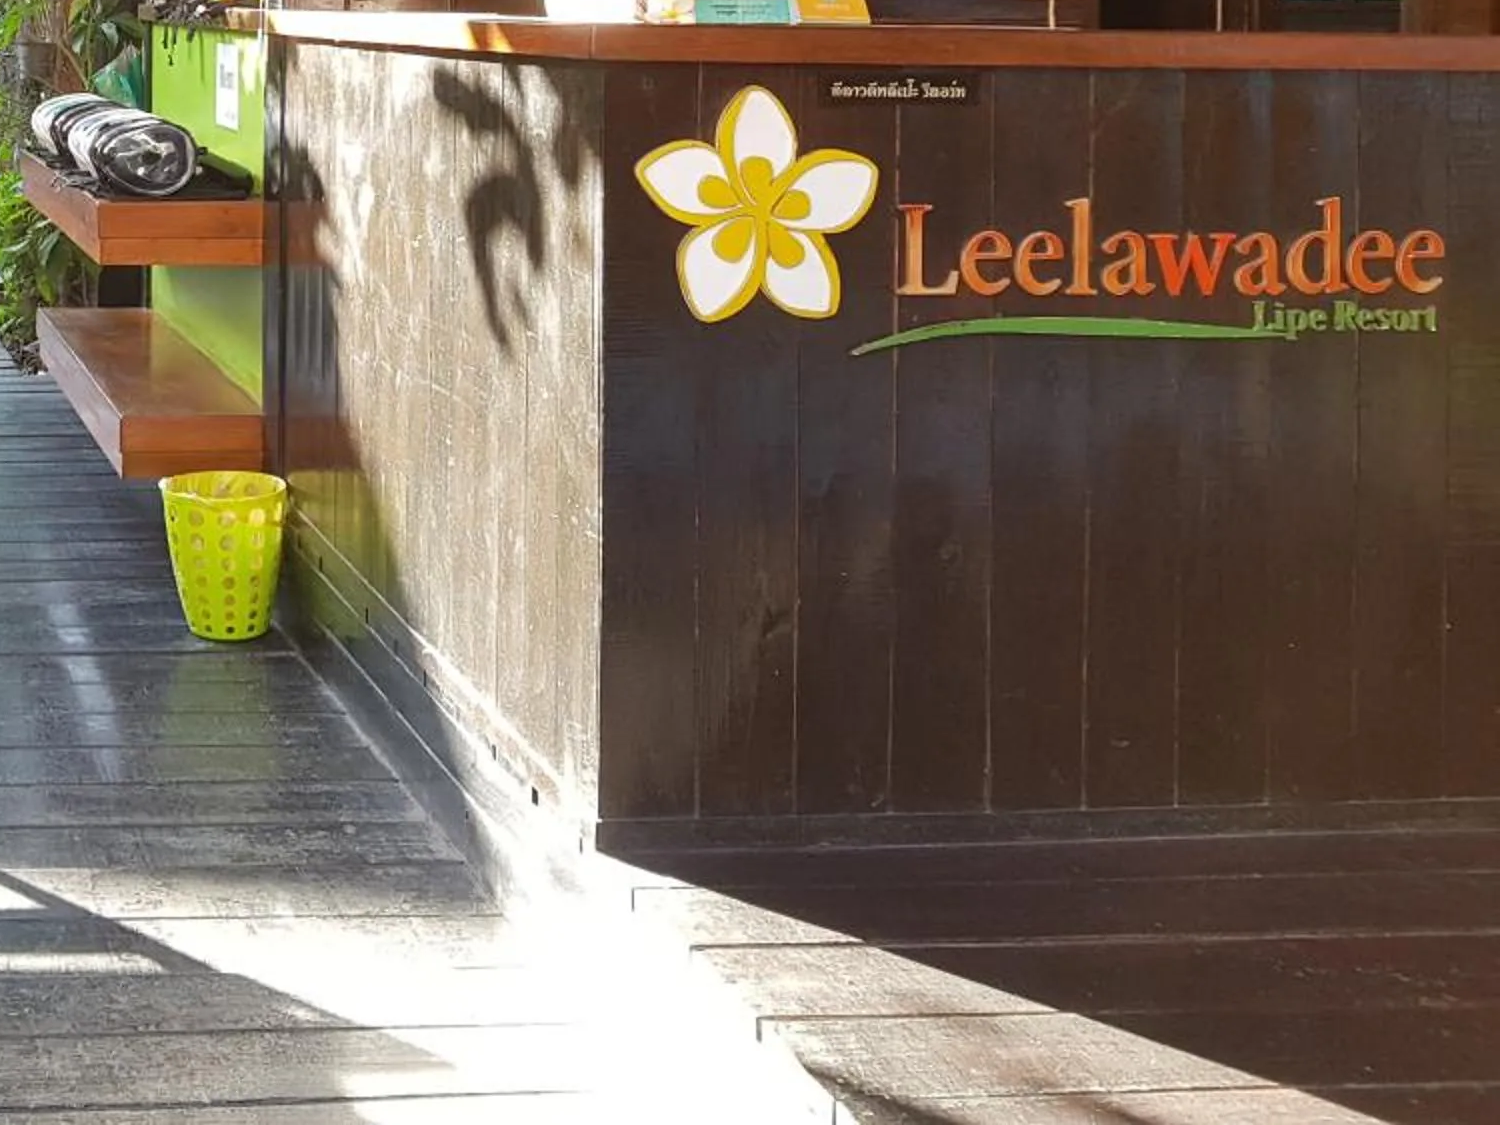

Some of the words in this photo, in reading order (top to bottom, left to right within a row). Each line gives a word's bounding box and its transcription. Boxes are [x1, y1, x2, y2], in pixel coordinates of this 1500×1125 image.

[896, 196, 1445, 296] Leelawadee
[1251, 300, 1328, 340] Lipe
[1334, 300, 1437, 332] Resort
